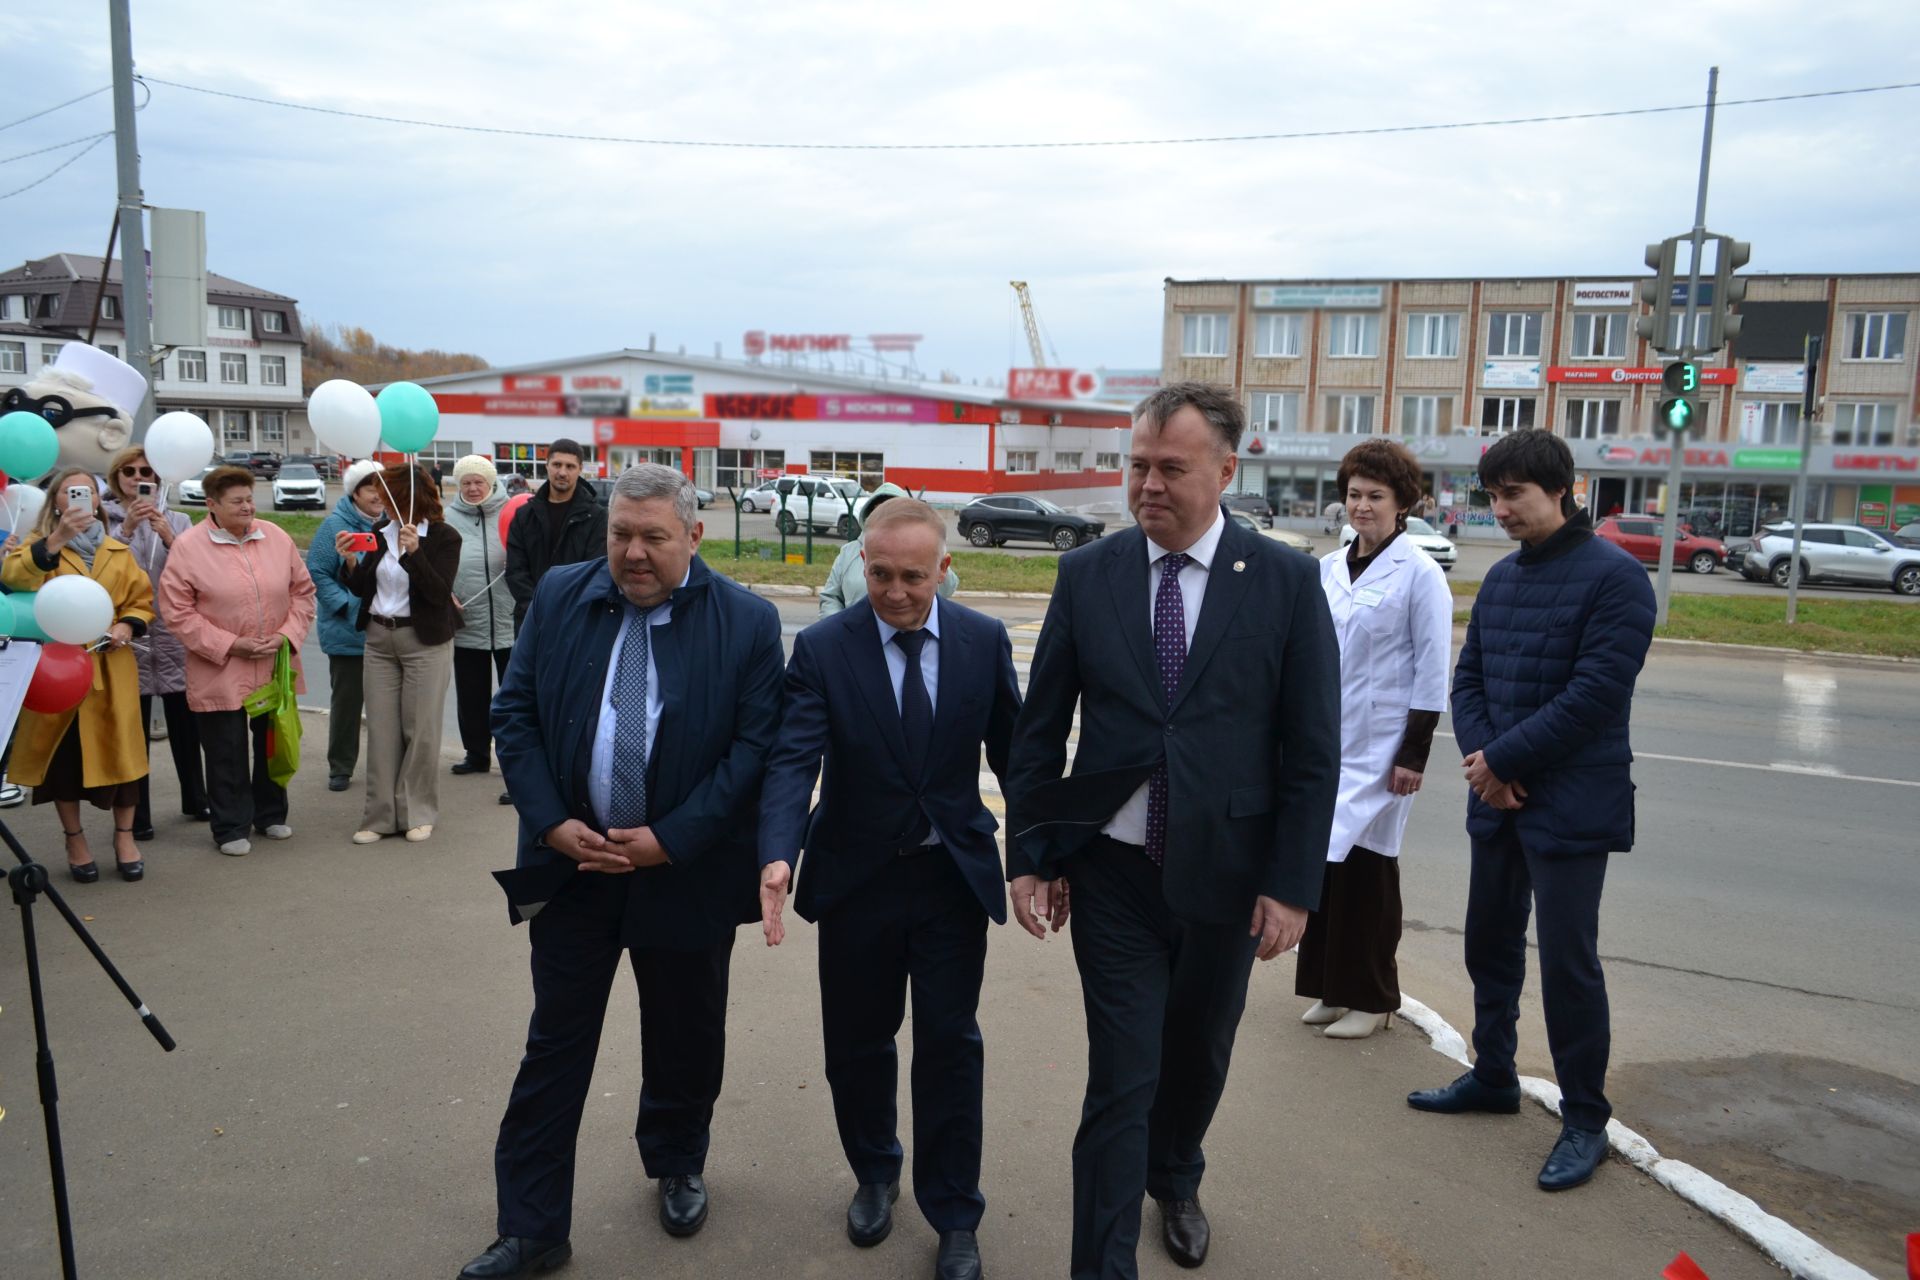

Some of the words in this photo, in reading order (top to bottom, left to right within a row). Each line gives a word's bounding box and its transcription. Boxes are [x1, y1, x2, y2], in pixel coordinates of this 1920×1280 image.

[1576, 290, 1630, 299] РОСГОССТРАХ
[769, 334, 850, 351] МАГНИТ
[1565, 371, 1598, 379] МАГАЗИН
[1611, 368, 1664, 382] Бристол
[1639, 447, 1729, 465] АПЕКА
[1833, 453, 1919, 471] ЦВЕТЫ
